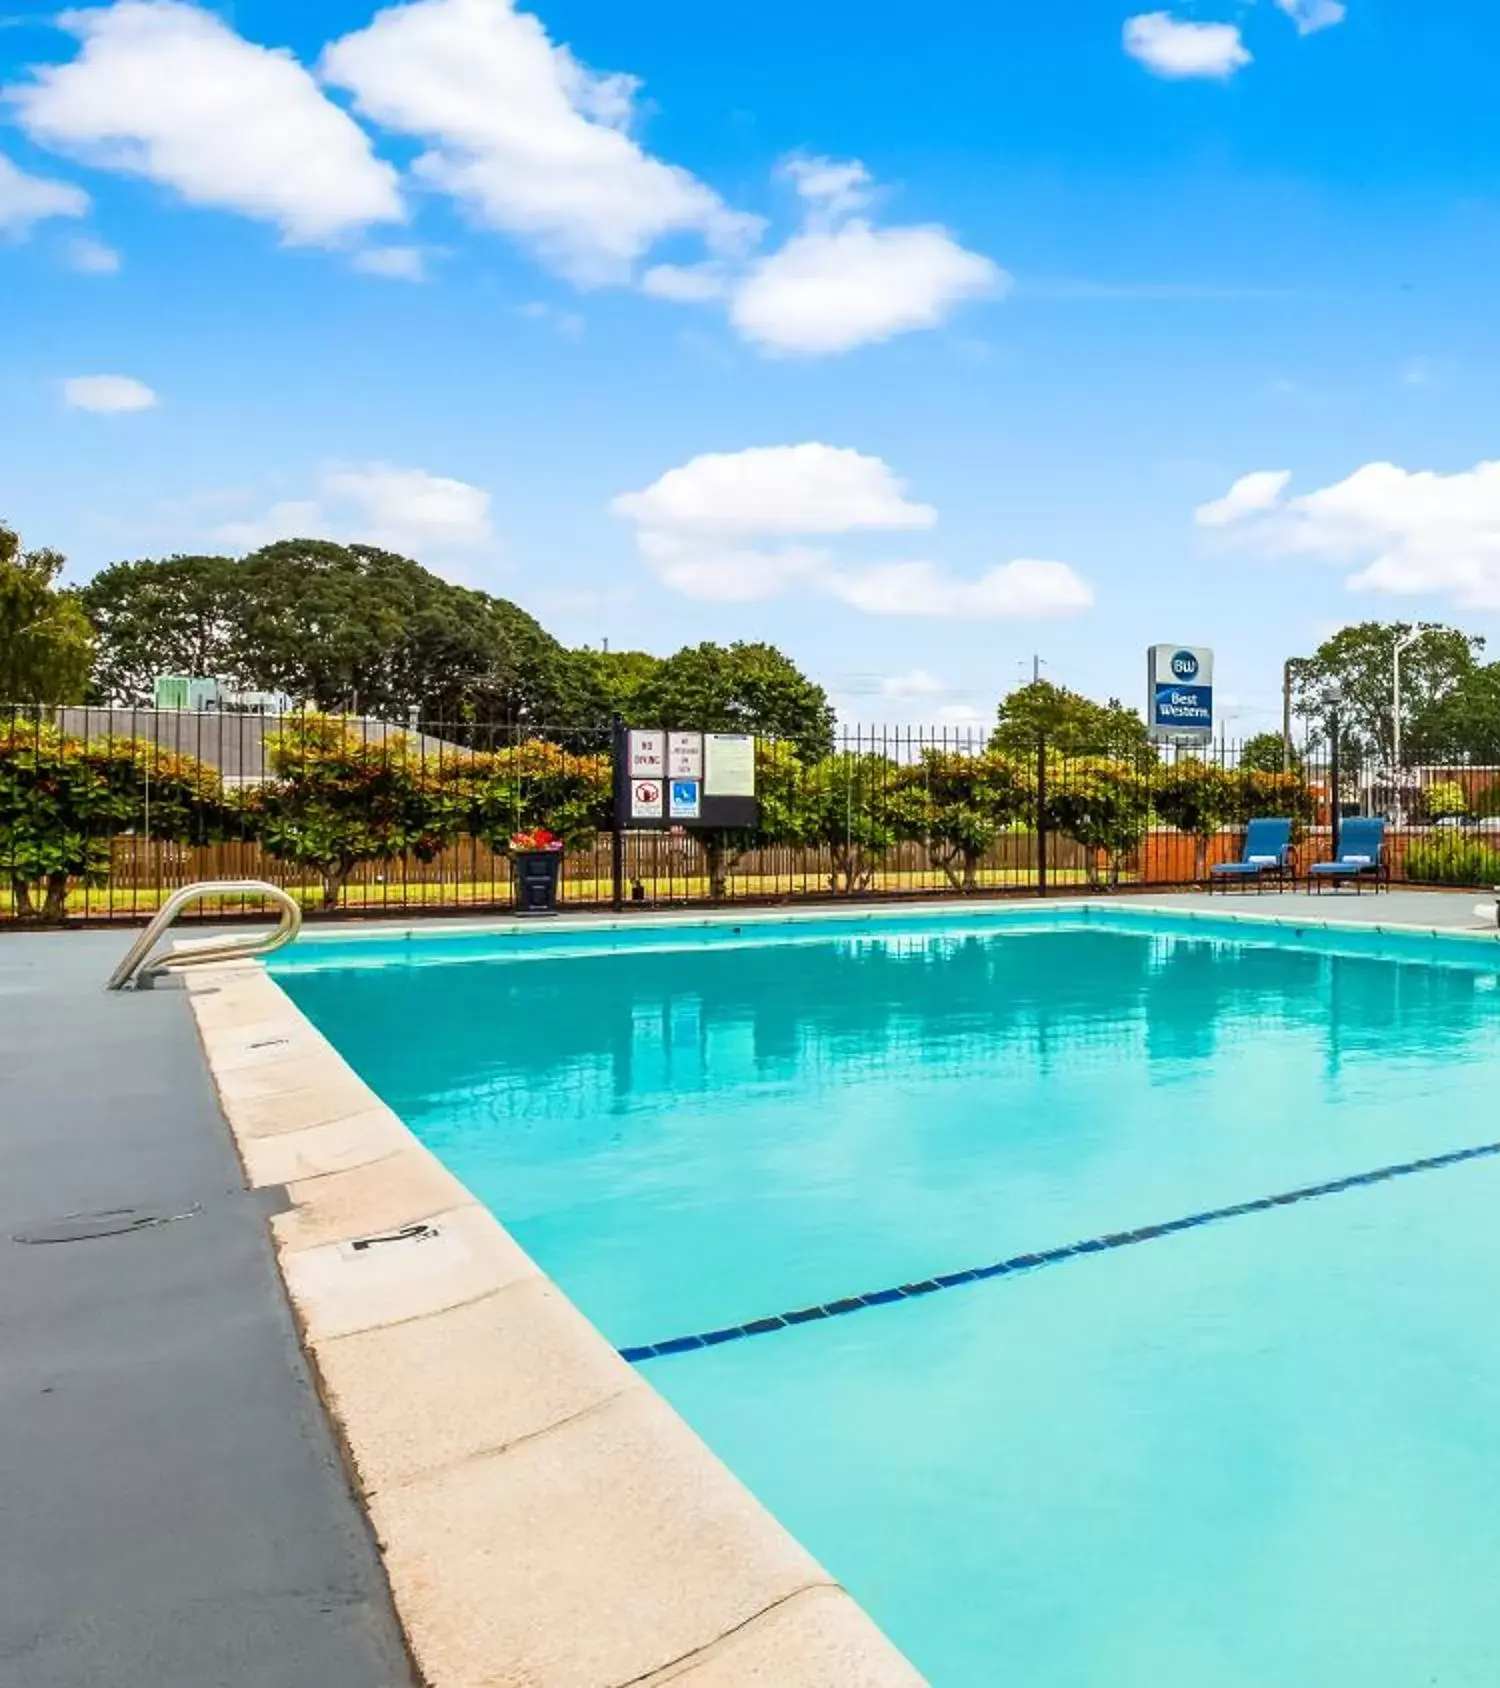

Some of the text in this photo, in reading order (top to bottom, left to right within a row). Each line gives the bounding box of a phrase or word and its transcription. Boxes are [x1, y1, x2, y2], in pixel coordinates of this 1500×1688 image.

[1174, 659, 1195, 673] BW
[1172, 692, 1197, 706] Best
[1160, 704, 1208, 717] Western
